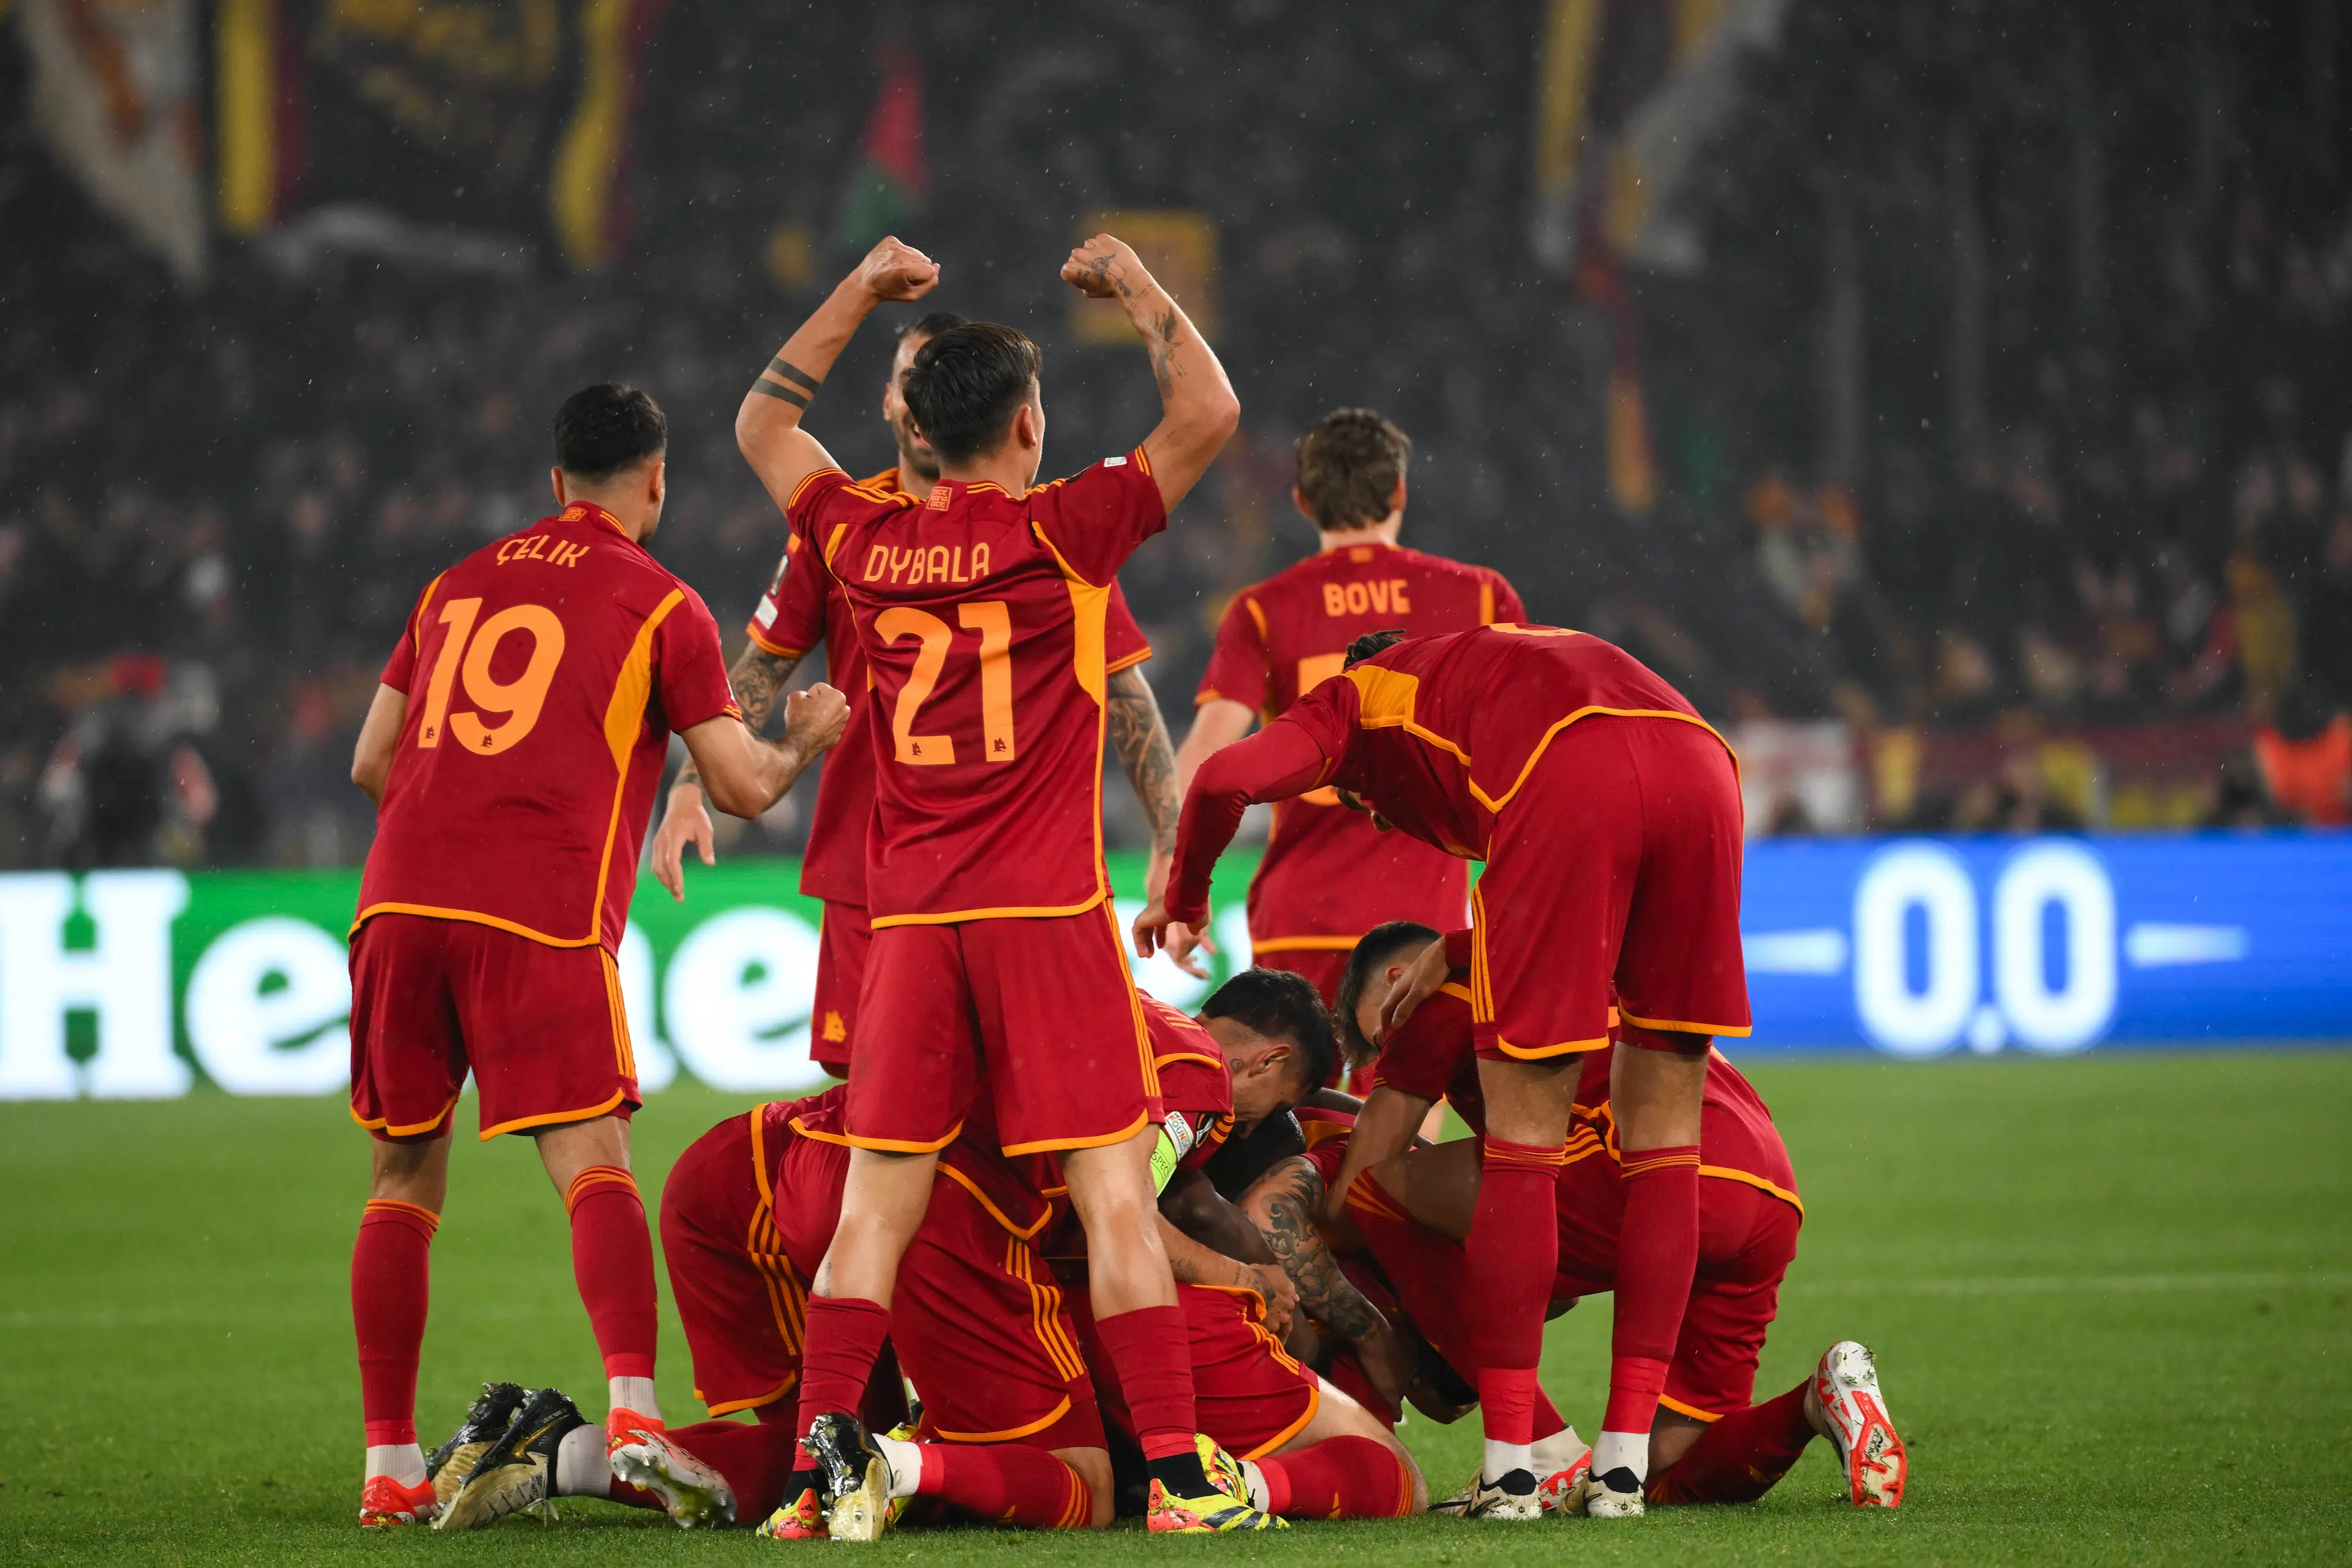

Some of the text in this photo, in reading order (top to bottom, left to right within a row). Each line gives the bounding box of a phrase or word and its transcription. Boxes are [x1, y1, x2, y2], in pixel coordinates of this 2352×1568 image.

[497, 535, 590, 568] ÇELIK
[864, 543, 990, 584] DYBALA
[1324, 579, 1410, 616] BOVE
[418, 597, 565, 756] 19
[874, 601, 1015, 766] 21
[1151, 1151, 1169, 1176] SPEC
